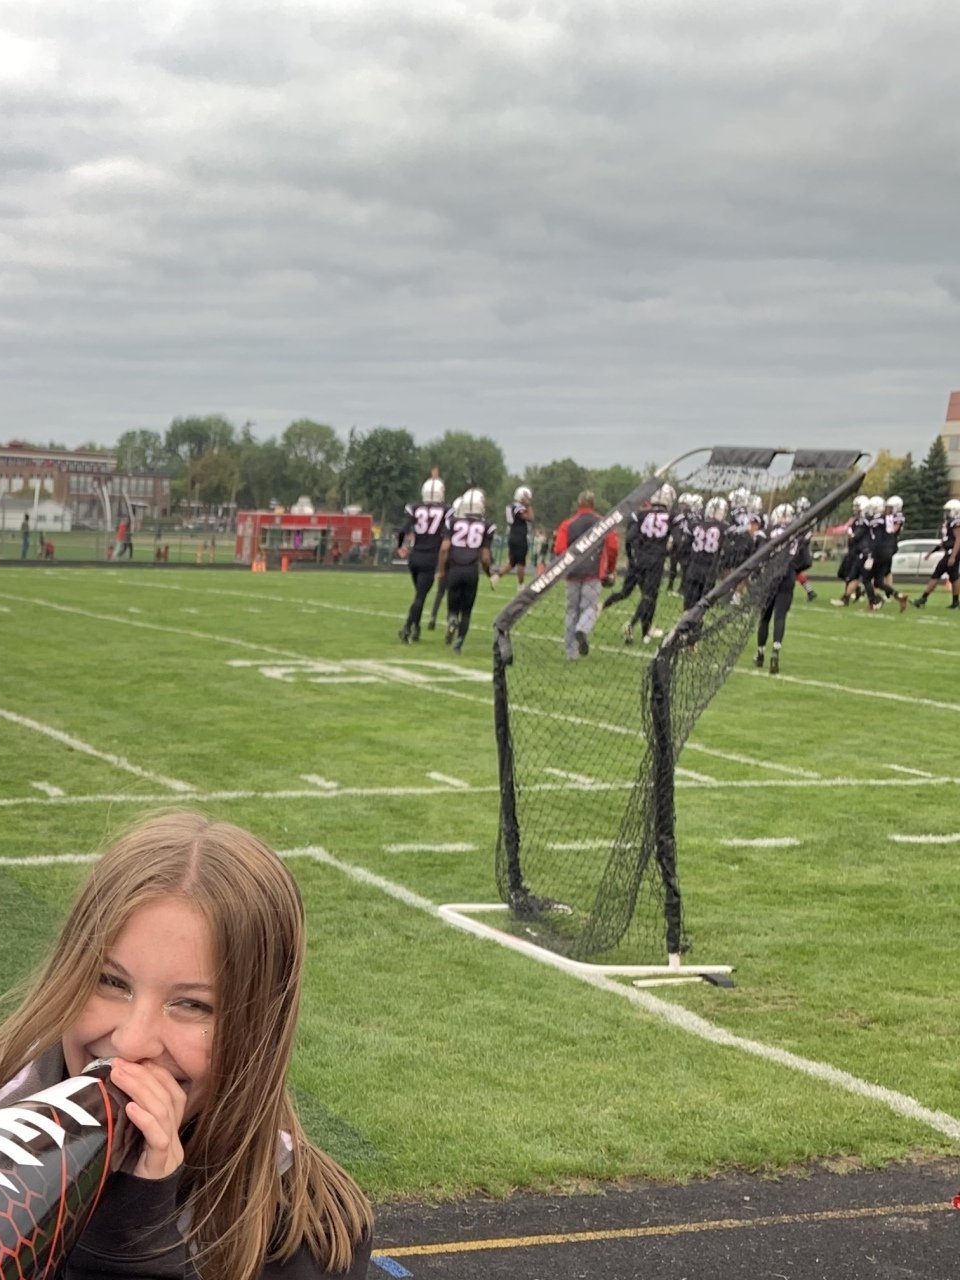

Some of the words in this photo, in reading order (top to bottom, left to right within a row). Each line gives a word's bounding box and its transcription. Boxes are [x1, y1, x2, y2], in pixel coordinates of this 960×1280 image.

[414, 508, 443, 535] 37
[452, 519, 486, 548] 26
[641, 512, 670, 538] 45
[530, 553, 575, 594] Wizard
[576, 510, 624, 553] Kicking
